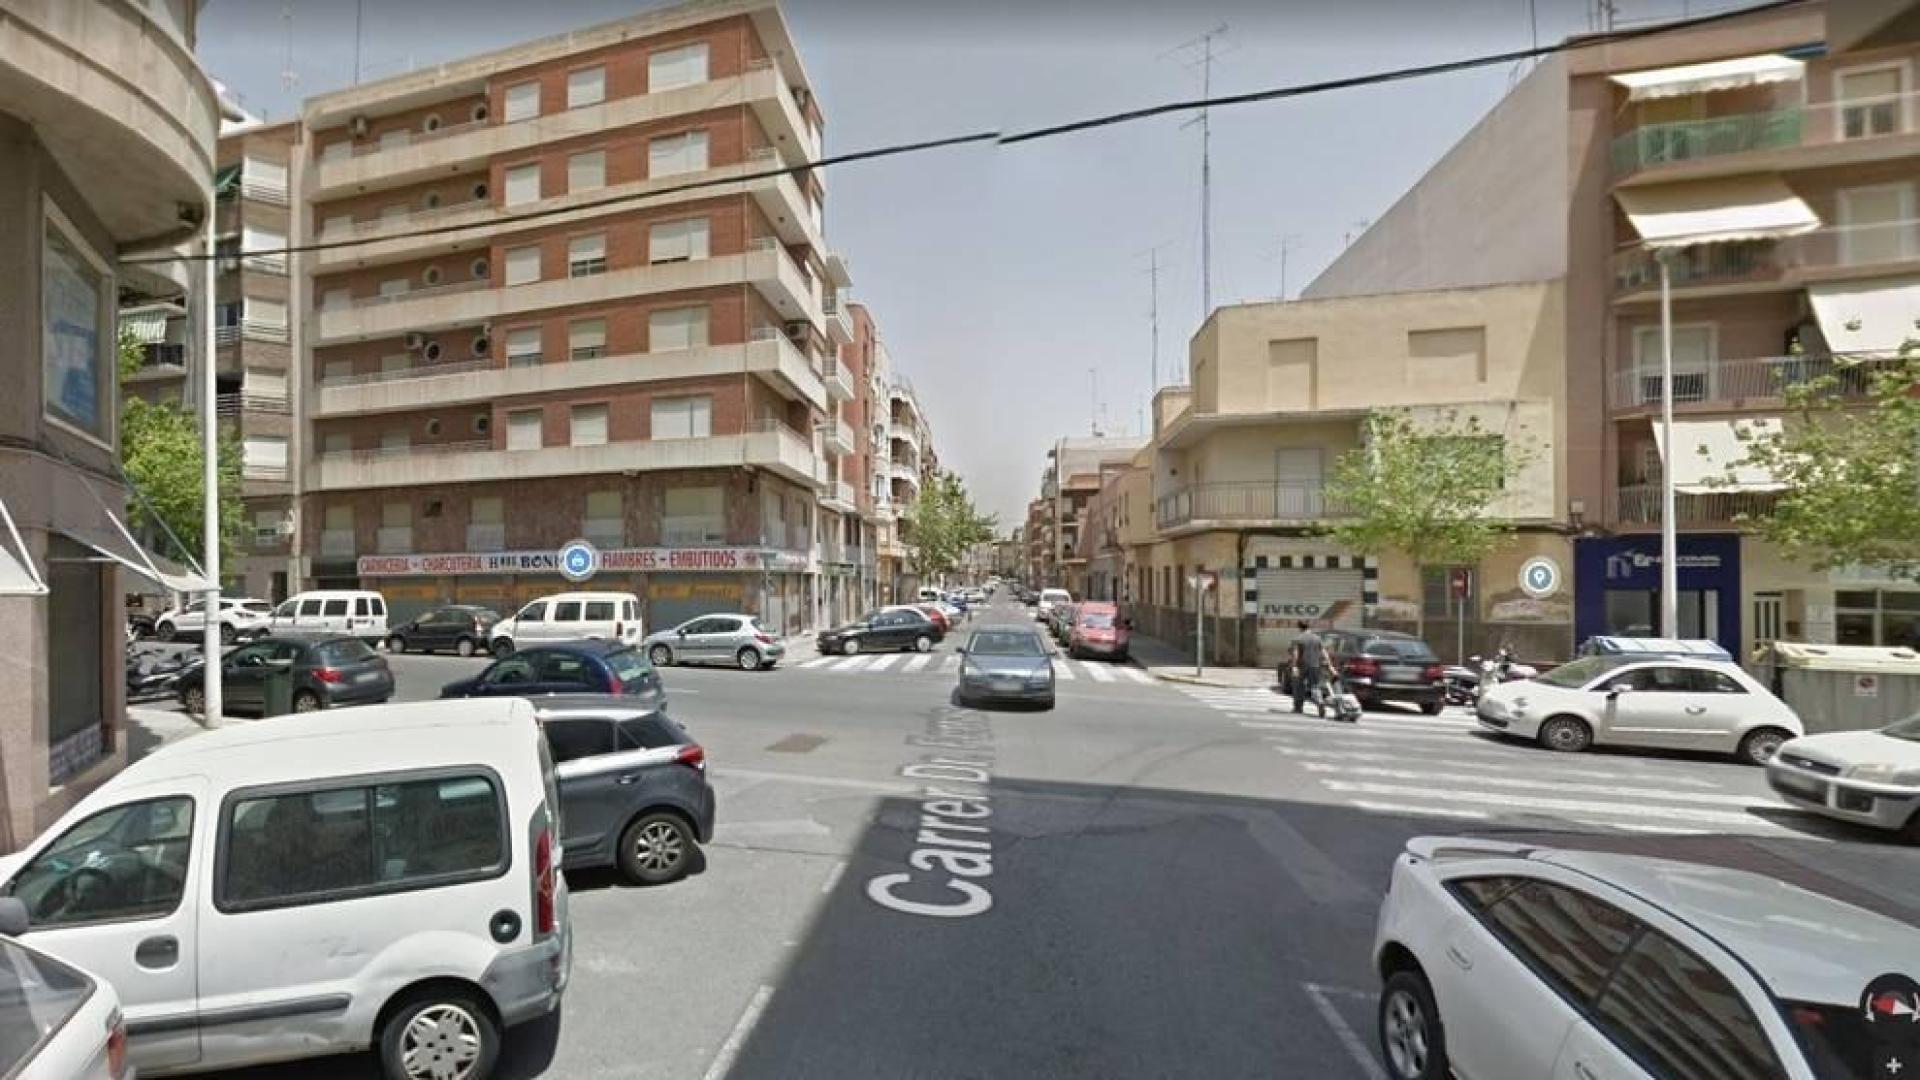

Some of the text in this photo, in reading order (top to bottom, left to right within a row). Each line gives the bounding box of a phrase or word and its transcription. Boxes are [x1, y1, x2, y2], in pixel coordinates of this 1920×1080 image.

[603, 552, 657, 568] FIAMBRES
[670, 550, 737, 567] EMBUTIDOS
[1264, 604, 1320, 616] IVECO
